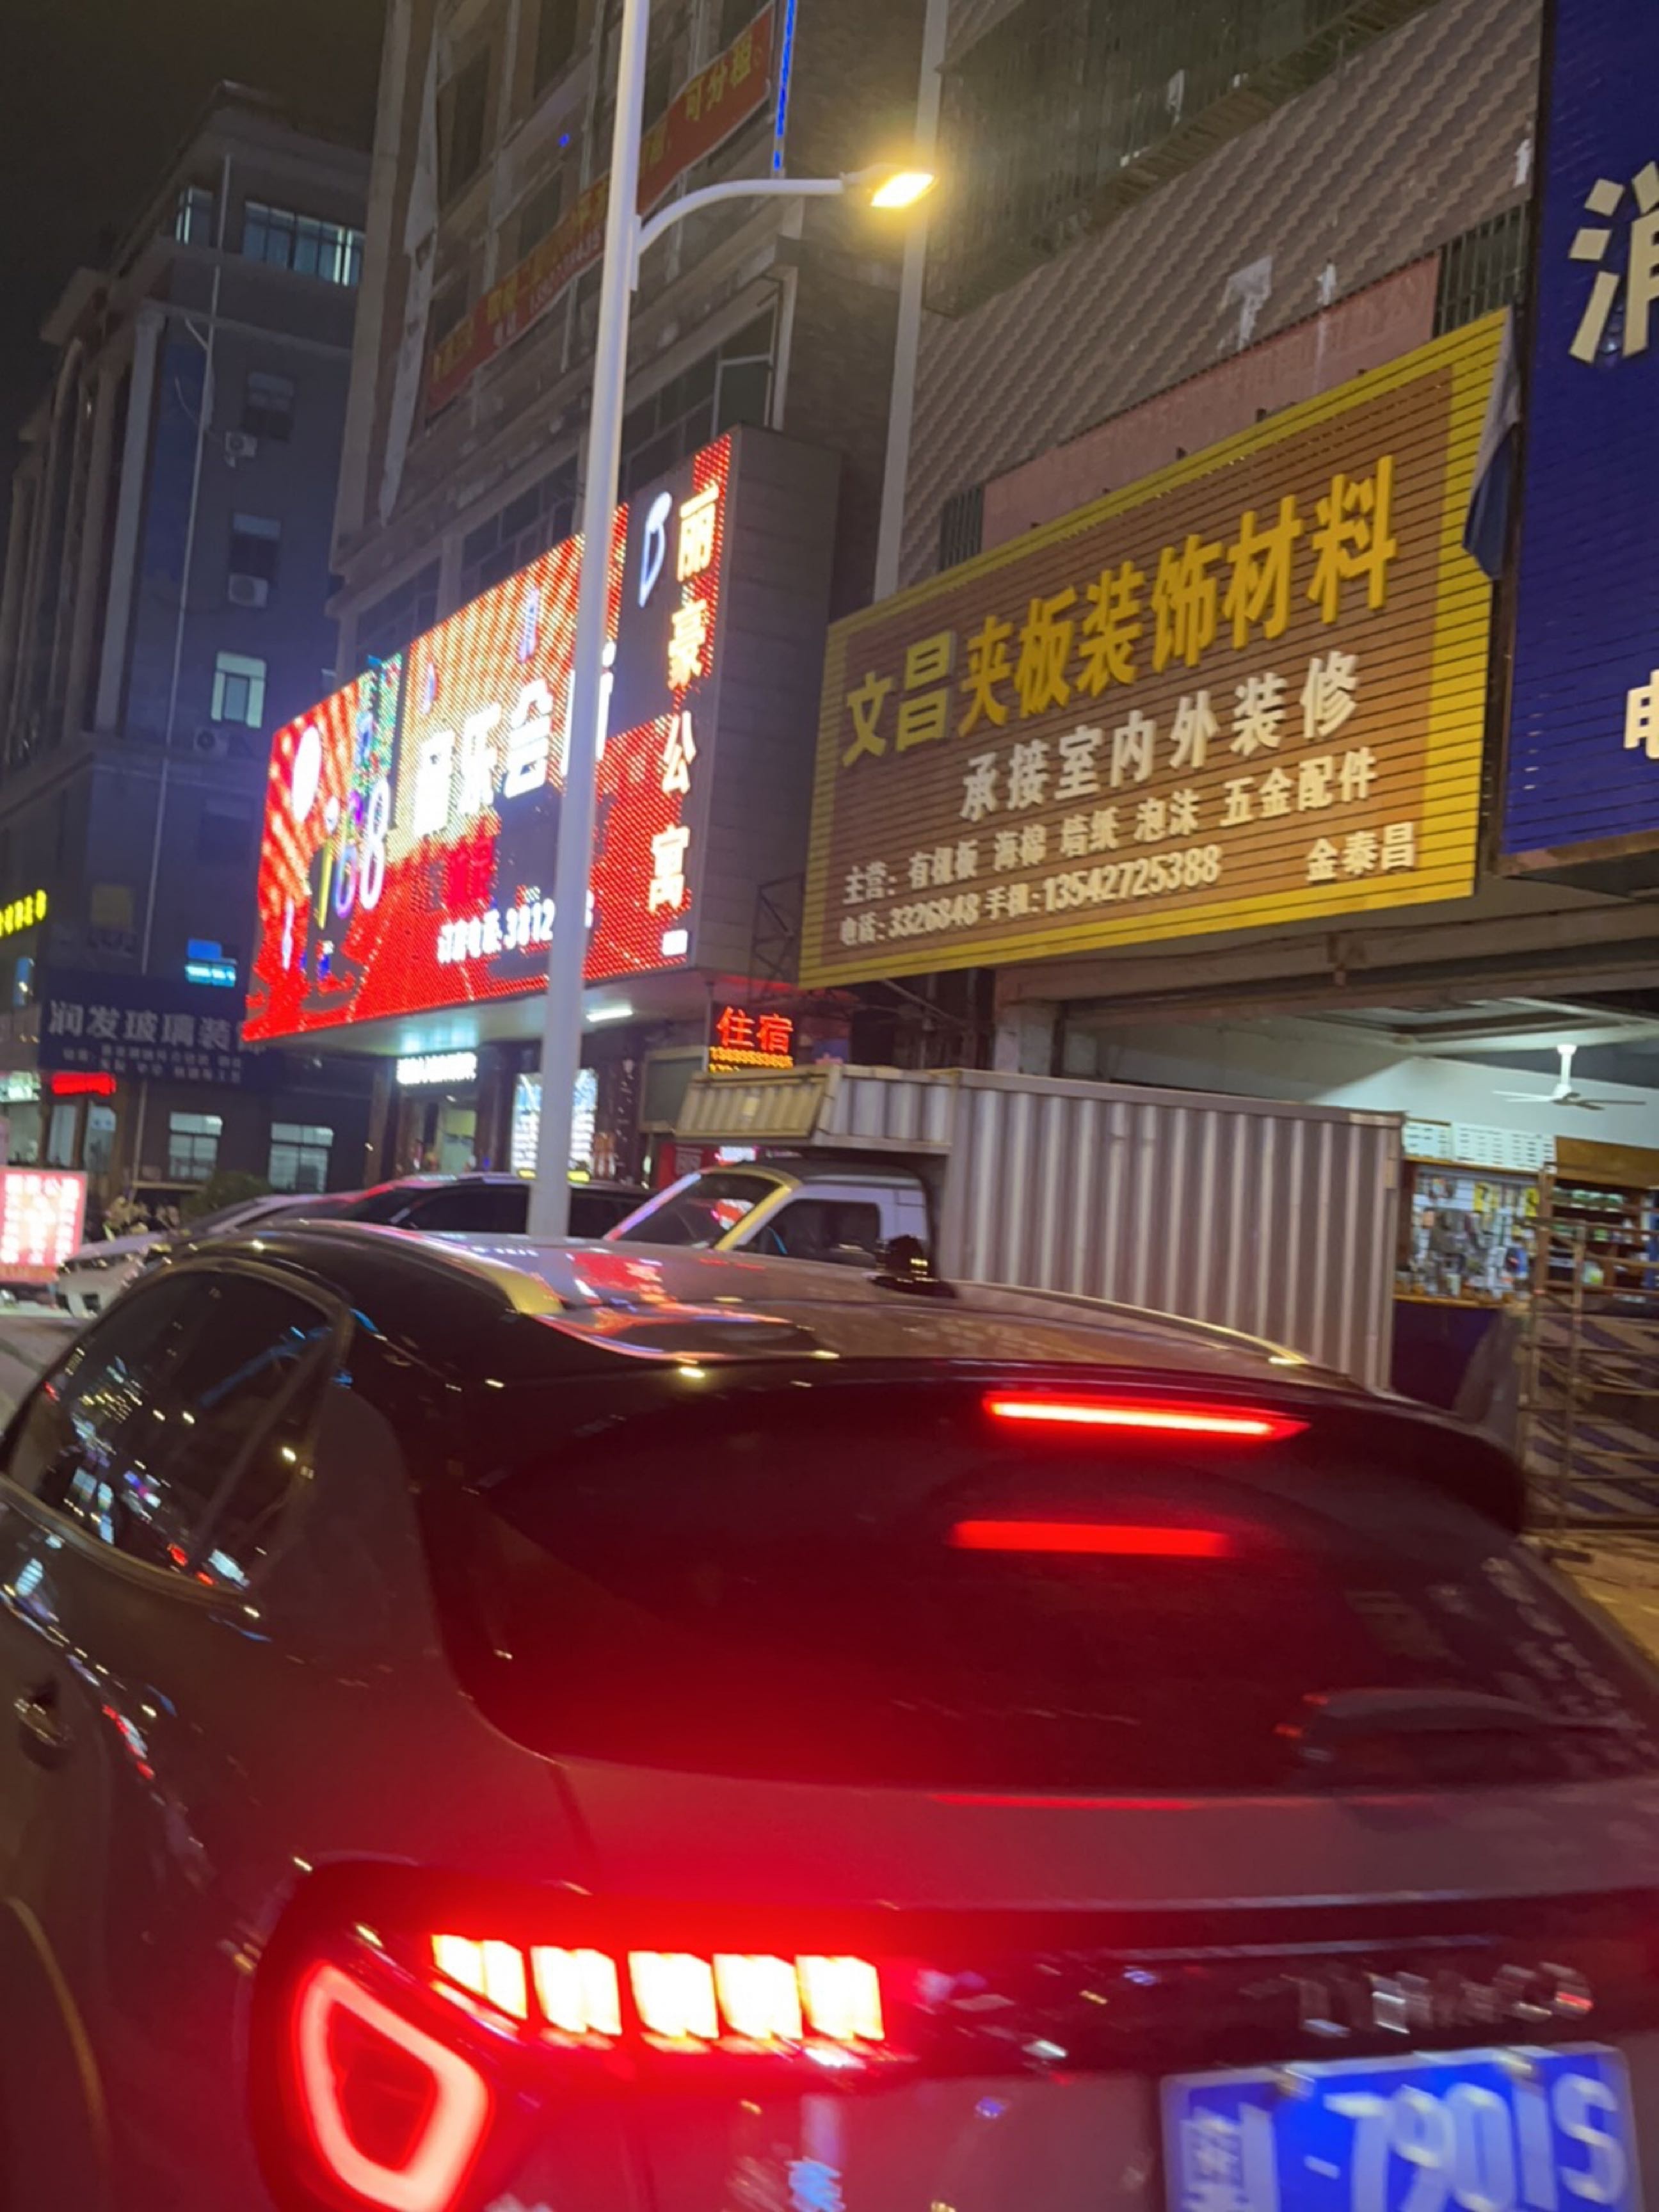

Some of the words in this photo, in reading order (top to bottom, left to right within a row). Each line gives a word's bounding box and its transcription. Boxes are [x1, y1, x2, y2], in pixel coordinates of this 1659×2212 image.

[842, 454, 1398, 766] 文昌夹板装饰材料
[646, 480, 719, 913] 丽豪公寓
[959, 650, 1360, 823] 承接室内外装修
[1133, 788, 1201, 842] 泡沫
[1220, 746, 1379, 828] 五金配件
[1306, 820, 1416, 883] 金泰昌
[48, 999, 266, 1055] 润发玻璃装
[716, 1006, 794, 1054] 住宿
